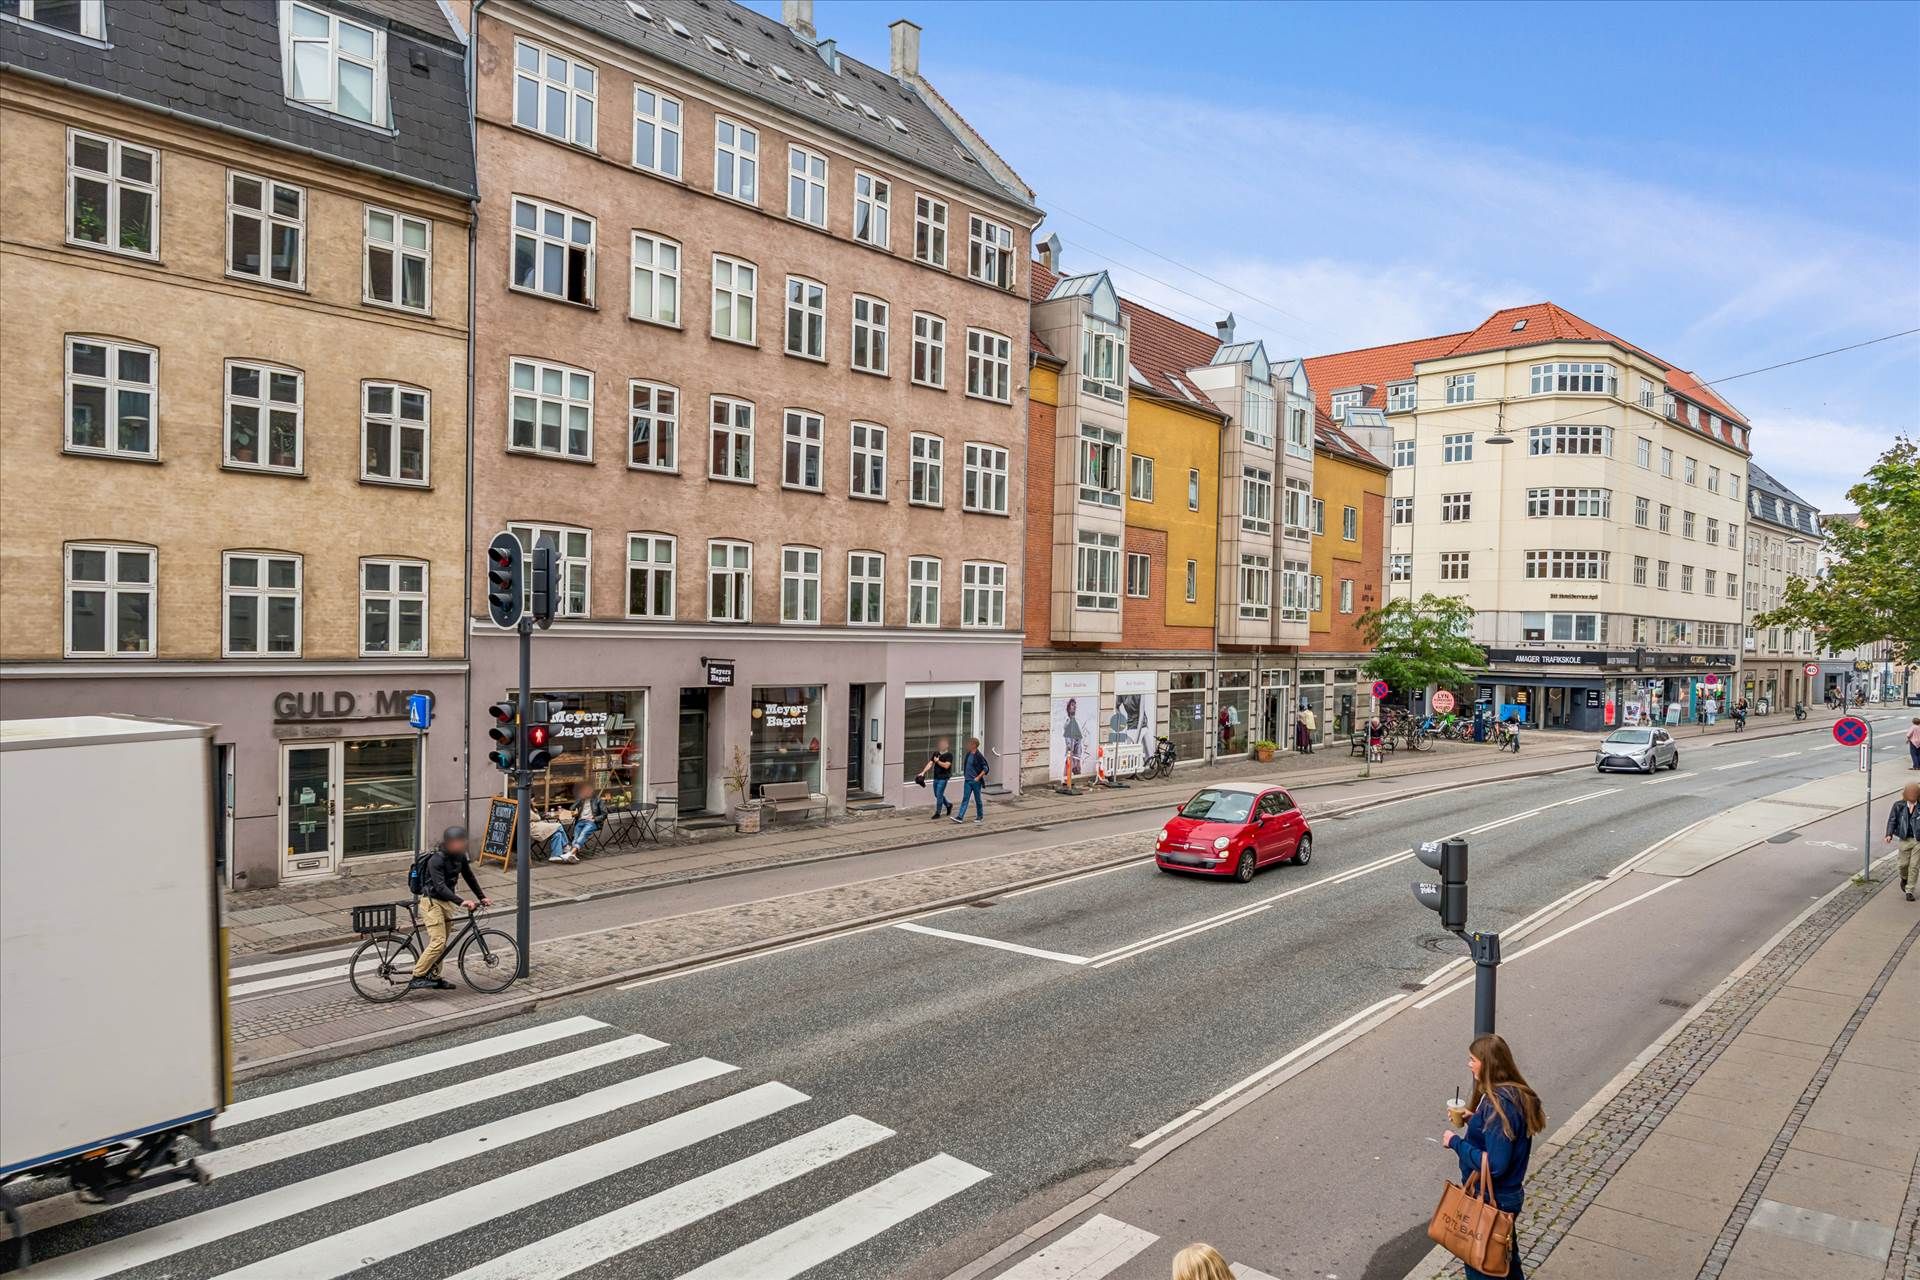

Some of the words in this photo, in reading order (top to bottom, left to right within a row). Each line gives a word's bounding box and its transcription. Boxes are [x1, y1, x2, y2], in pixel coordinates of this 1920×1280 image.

[1515, 655, 1540, 663] AMAGER
[1542, 655, 1581, 664] TRAFIKSKOLE
[710, 667, 731, 676] Meyers
[710, 674, 731, 683] Bageri
[274, 691, 355, 718] GULD
[765, 703, 809, 715] Meyers
[550, 710, 608, 724] Meyers
[766, 715, 807, 727] Bageri
[1460, 1225, 1483, 1240] BAG
